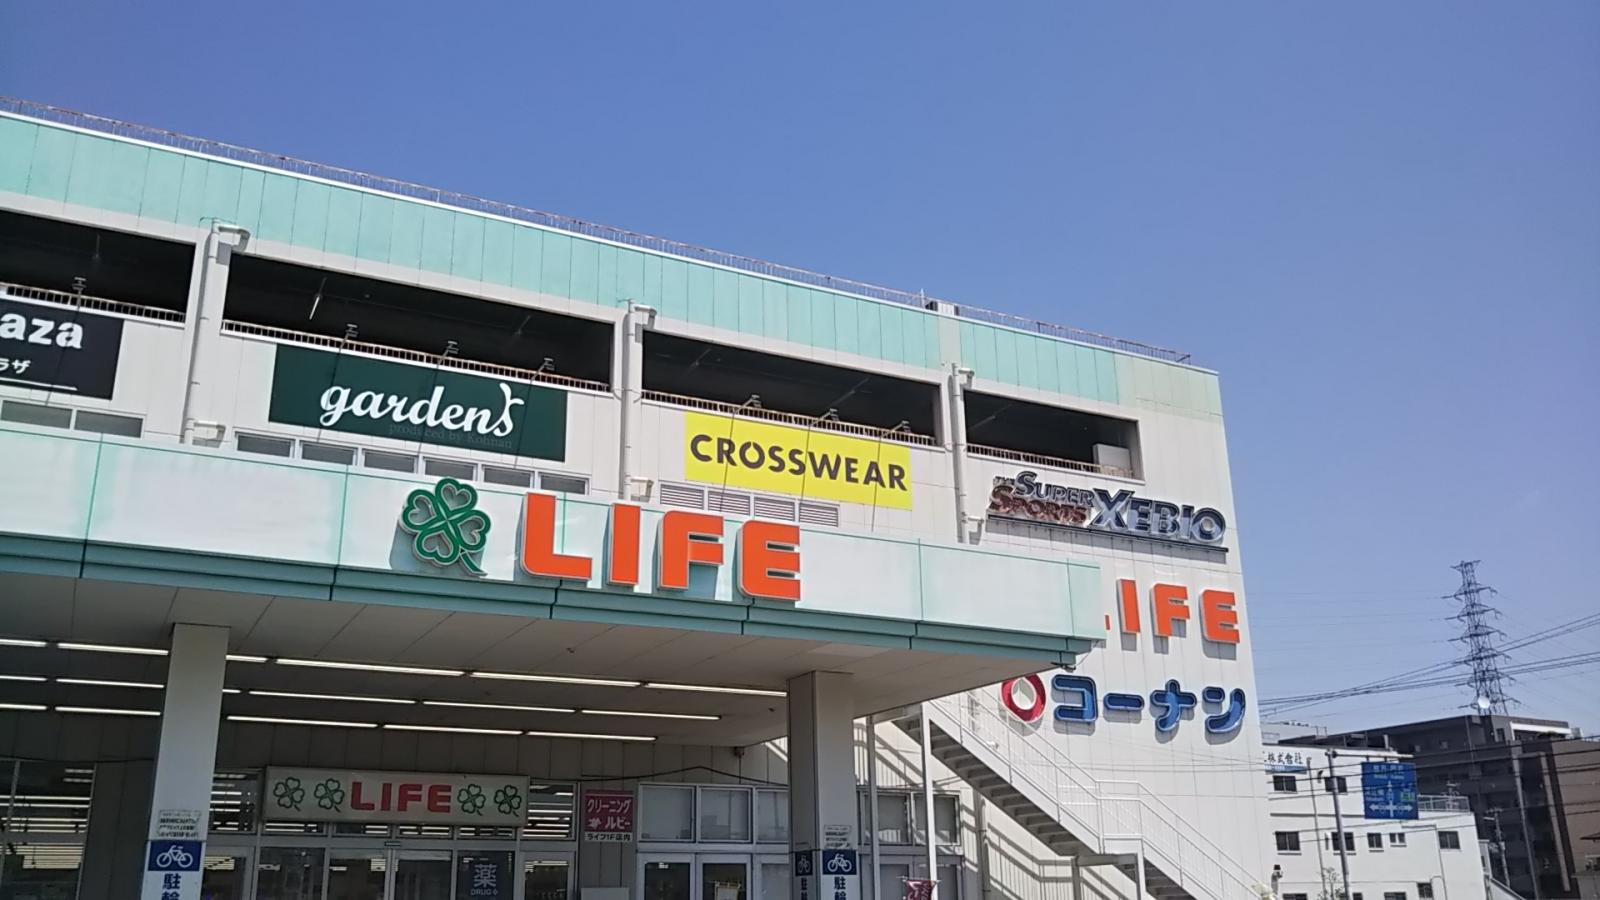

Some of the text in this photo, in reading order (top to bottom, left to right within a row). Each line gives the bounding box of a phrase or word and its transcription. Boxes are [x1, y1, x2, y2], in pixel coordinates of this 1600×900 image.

[690, 433, 907, 492] CROSSWEAR
[988, 484, 1089, 526] SPORTS
[1014, 470, 1096, 507] SUPER
[1090, 488, 1227, 544] XEBIO
[520, 491, 802, 602] LIFE
[1104, 578, 1241, 644] IFE
[1051, 673, 1246, 735] コーナン
[351, 781, 452, 813] LIFE
[587, 799, 632, 814] クリーニング
[604, 816, 631, 830] ルビー
[473, 864, 497, 888] 薬
